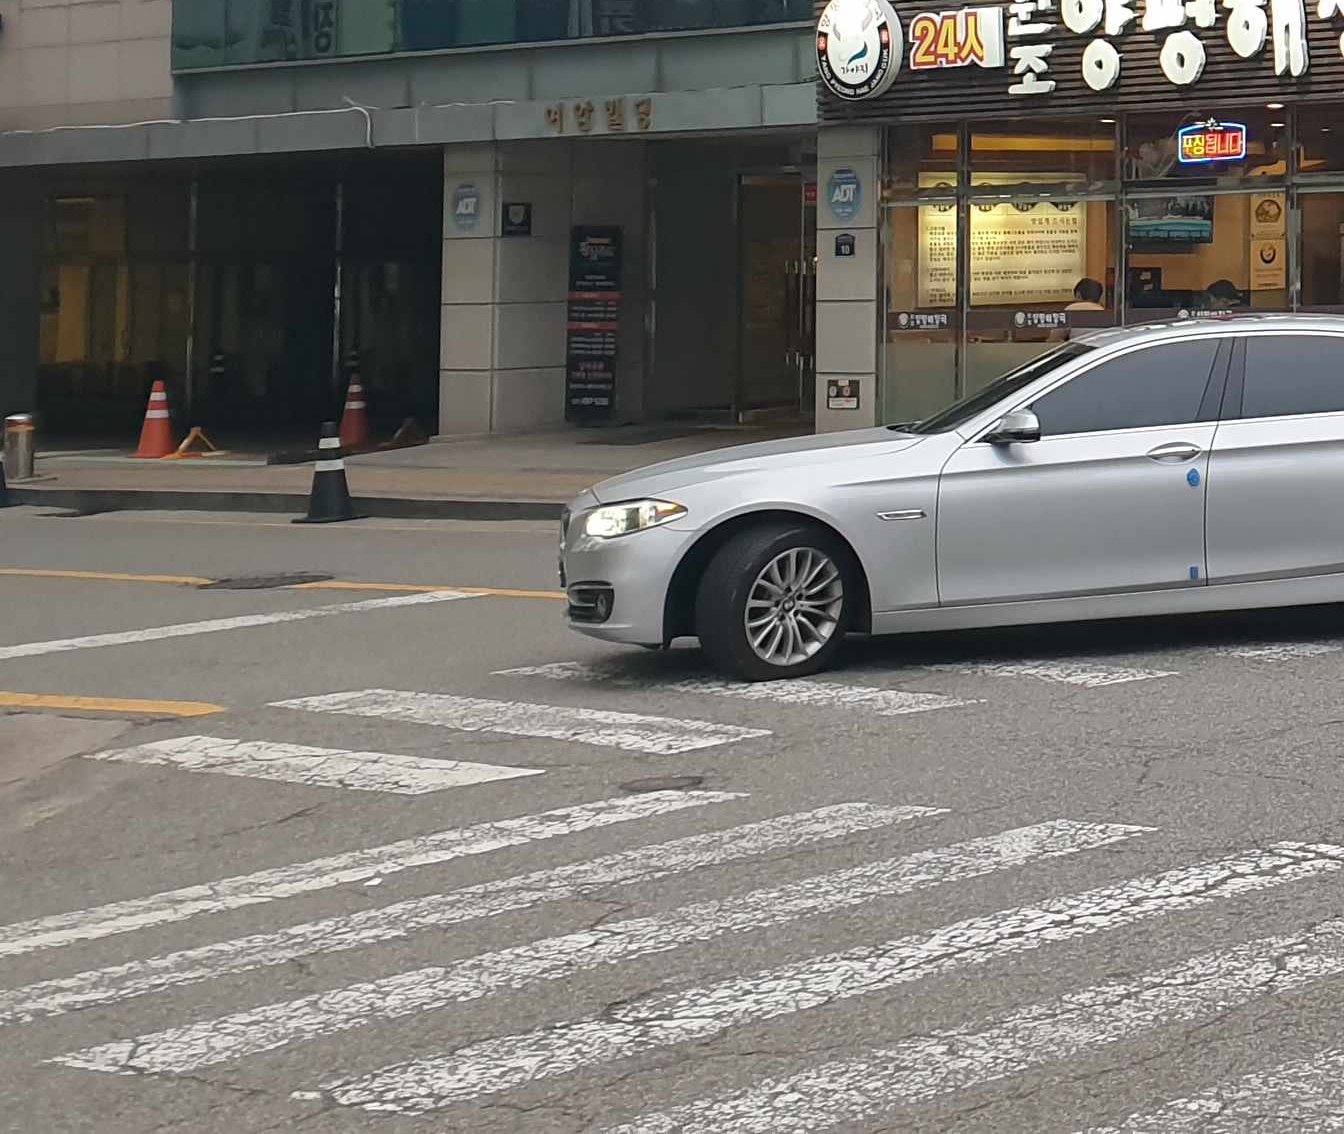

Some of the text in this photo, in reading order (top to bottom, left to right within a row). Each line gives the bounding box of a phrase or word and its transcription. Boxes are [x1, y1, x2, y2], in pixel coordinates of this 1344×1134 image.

[832, 184, 857, 204] ADT
[455, 198, 477, 215] ADT
[840, 245, 850, 254] 10
